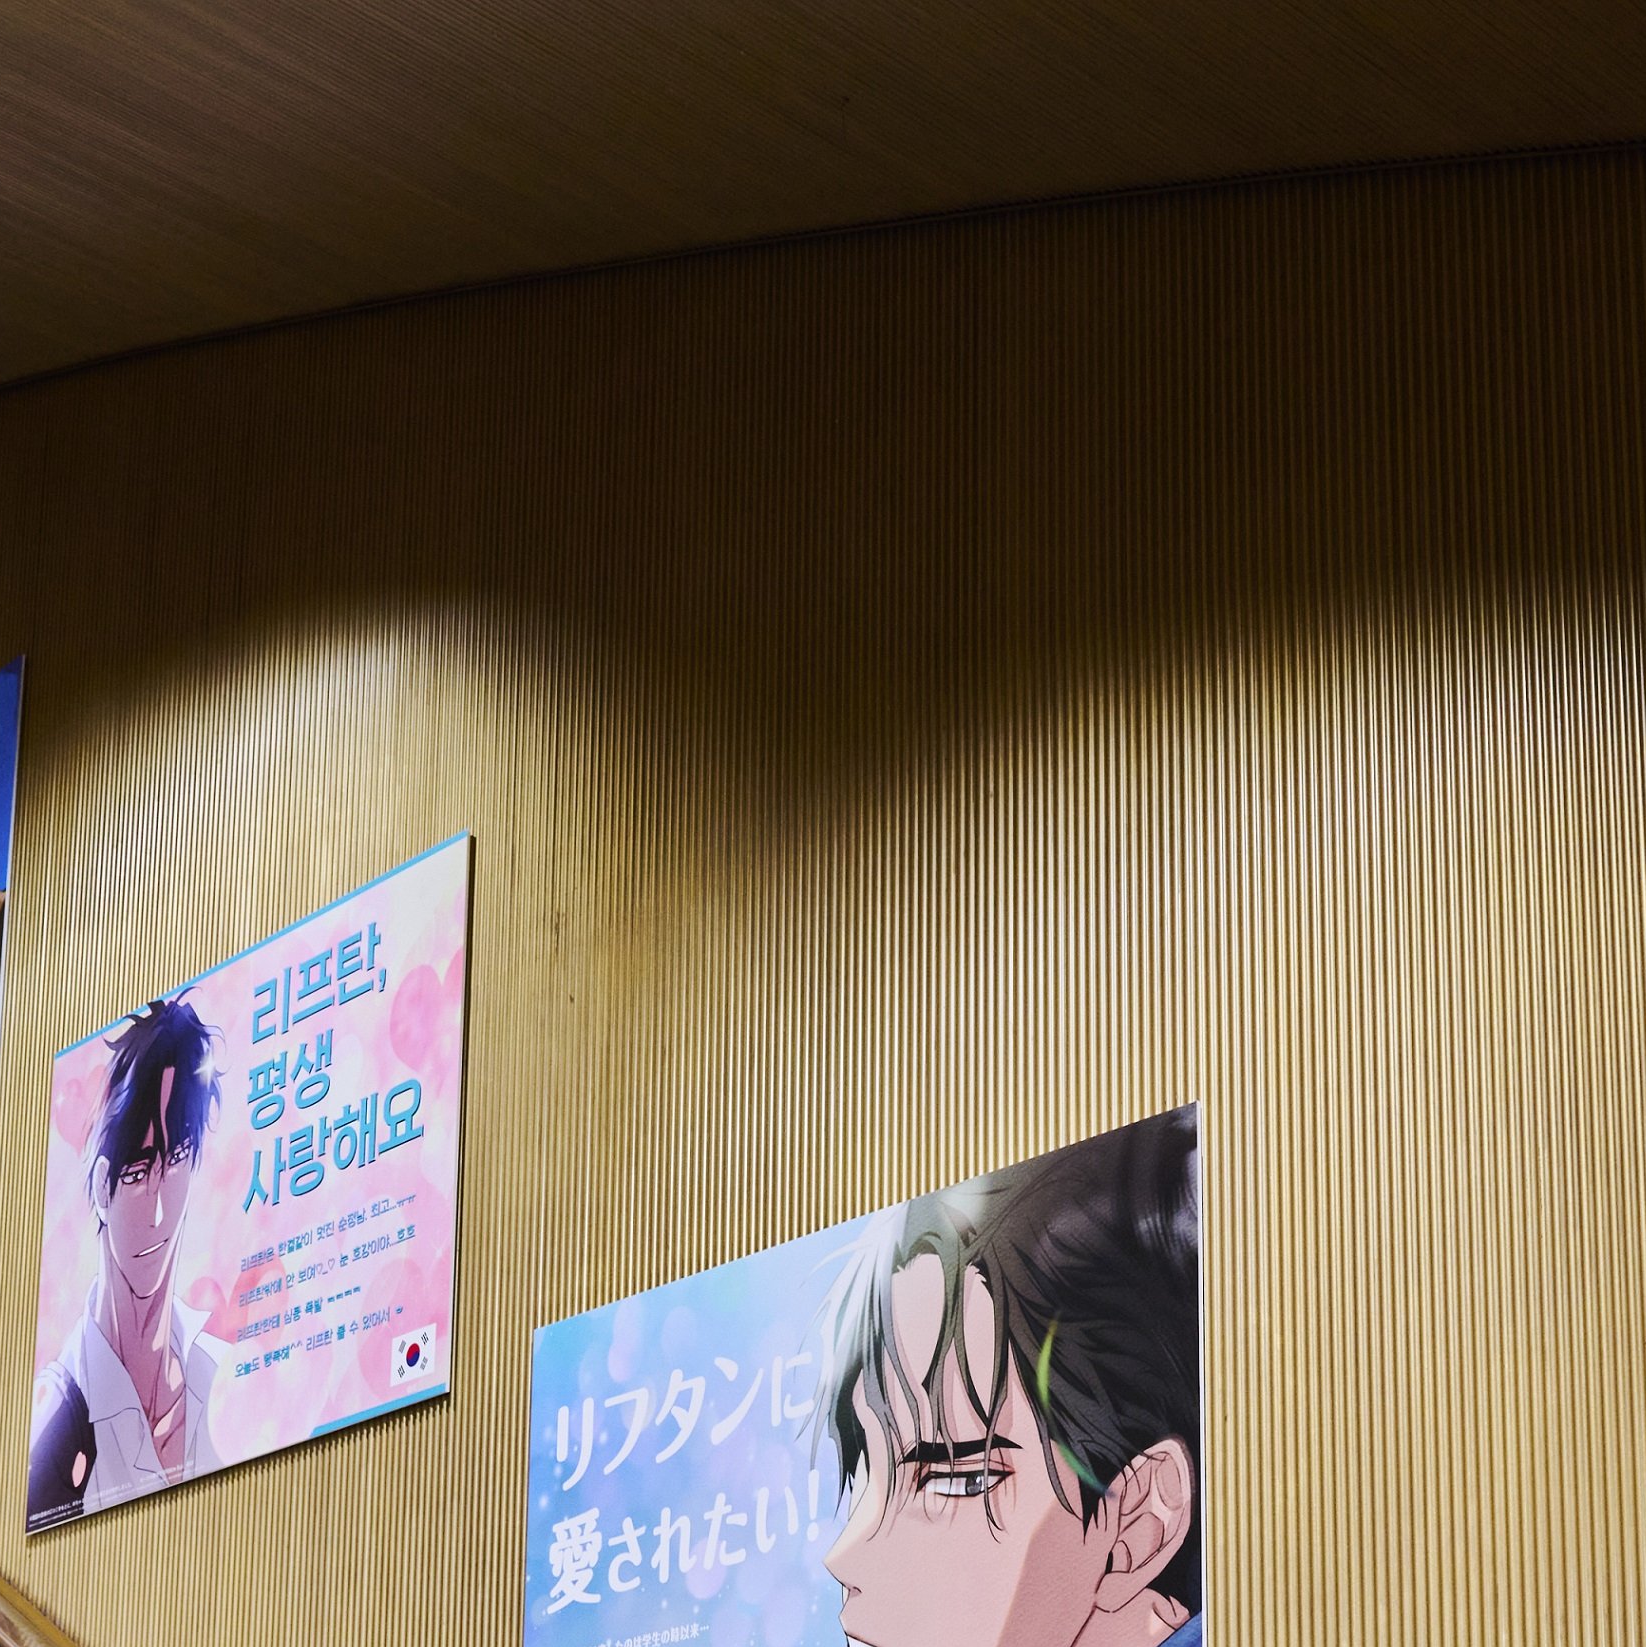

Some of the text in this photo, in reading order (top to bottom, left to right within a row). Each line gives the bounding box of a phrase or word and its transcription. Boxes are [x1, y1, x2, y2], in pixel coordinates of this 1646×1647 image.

[250, 922, 389, 1046] 리프탄,
[246, 1029, 334, 1133] 평생
[241, 1078, 426, 1216] 사랑해요
[286, 1272, 295, 1289] 안
[306, 1329, 333, 1351] 리프탄
[349, 1320, 359, 1335] 수
[362, 1306, 391, 1330] 있어서
[556, 1351, 815, 1492] リフタンに
[547, 1469, 820, 1615] 愛されたい!
